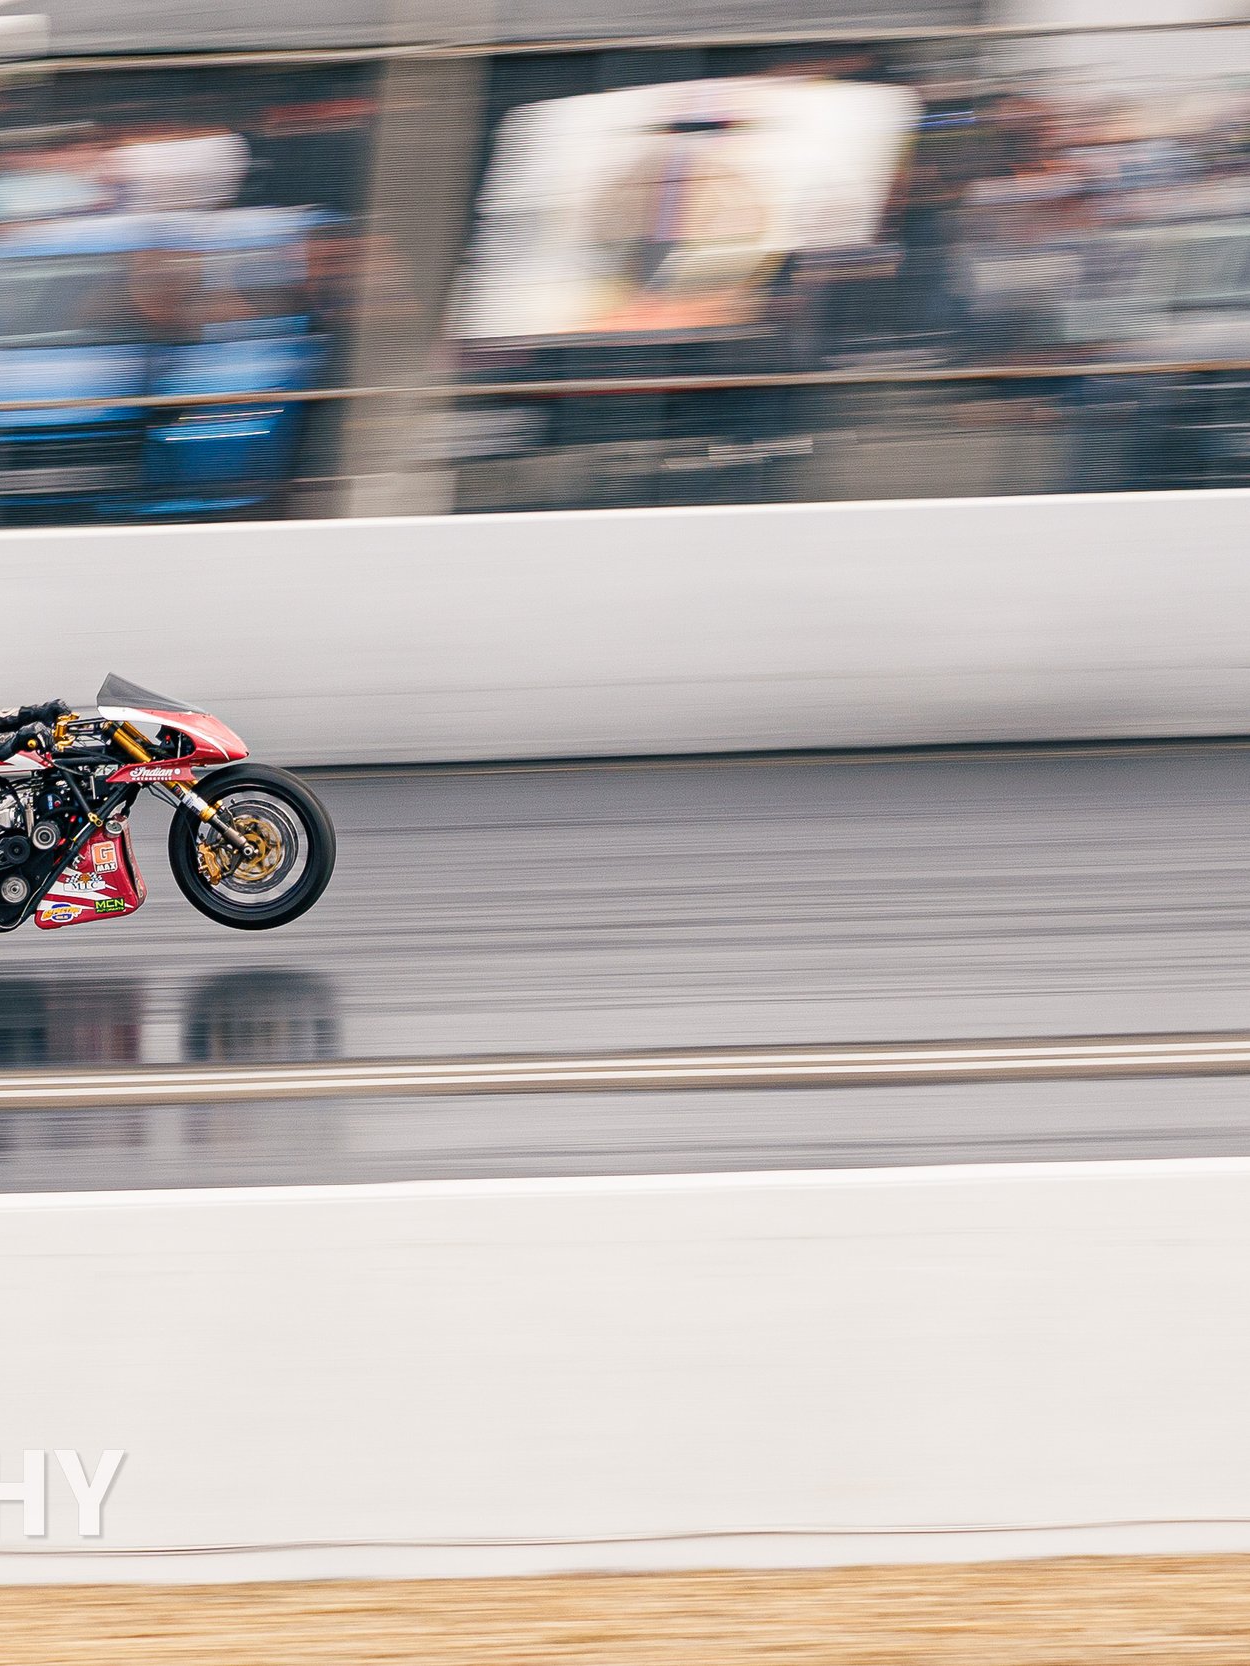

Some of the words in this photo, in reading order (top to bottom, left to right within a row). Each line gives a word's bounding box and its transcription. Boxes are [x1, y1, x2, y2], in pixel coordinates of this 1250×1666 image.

[130, 766, 173, 777] Indian
[96, 862, 116, 872] MAX
[96, 899, 124, 909] MCN
